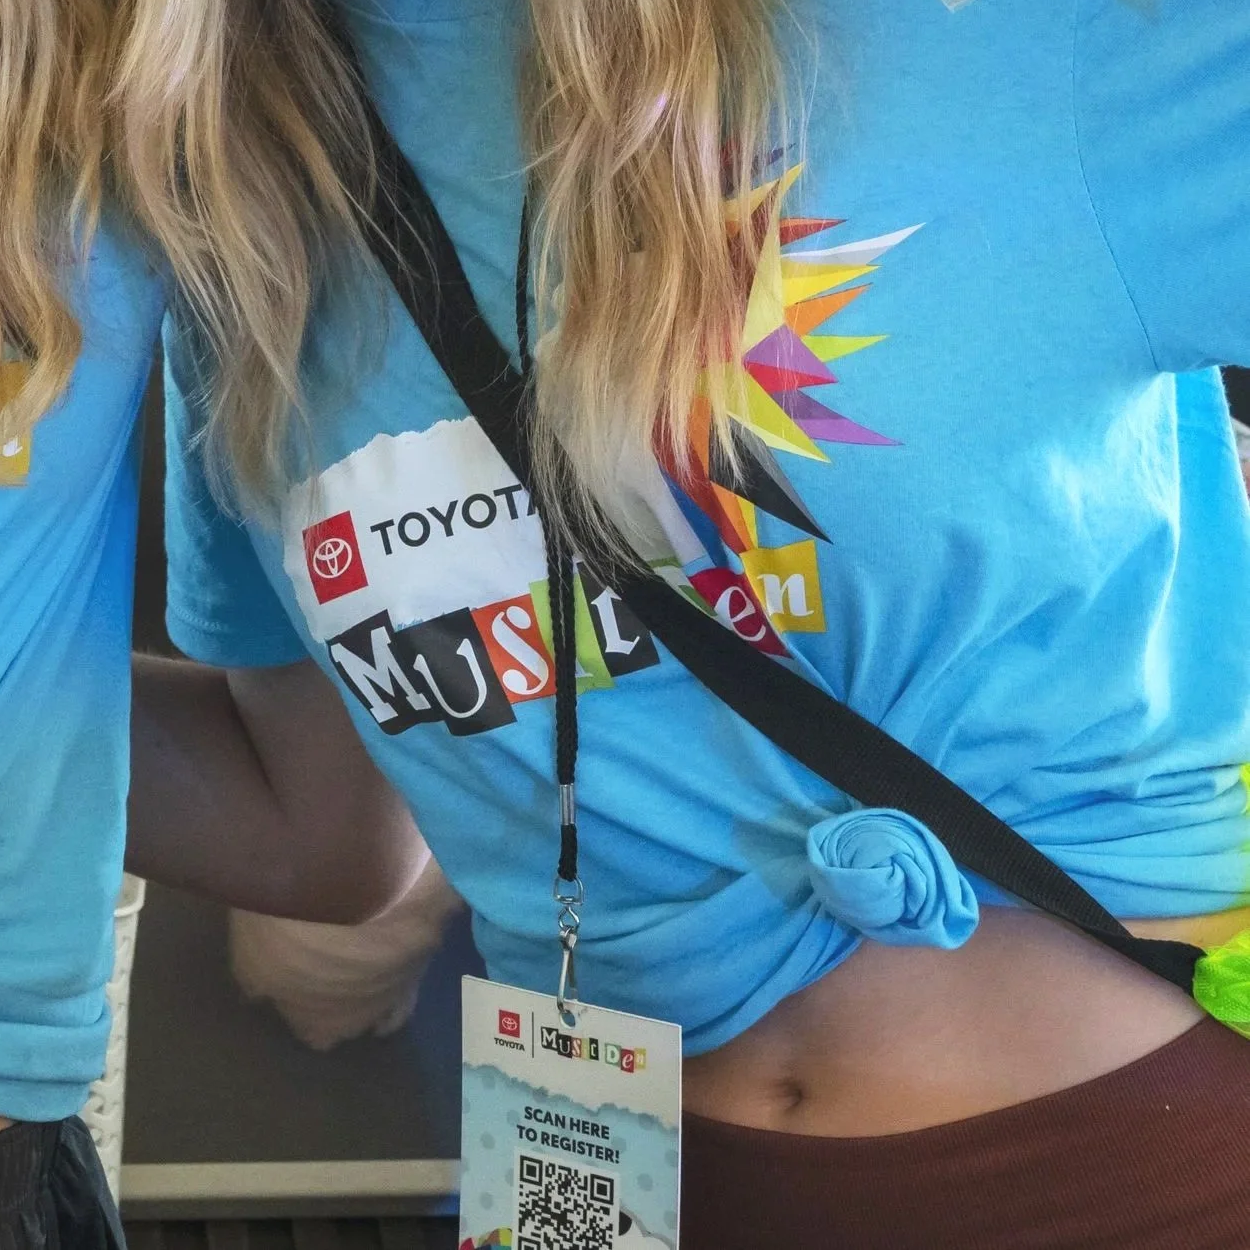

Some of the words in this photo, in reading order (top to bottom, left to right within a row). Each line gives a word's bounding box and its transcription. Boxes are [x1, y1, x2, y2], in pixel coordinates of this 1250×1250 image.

[494, 1037, 525, 1051] TOYOTA
[524, 1106, 566, 1129] SCAN
[570, 1117, 610, 1140] HERE
[516, 1124, 538, 1142] TO
[541, 1131, 620, 1164] REGISTER!
